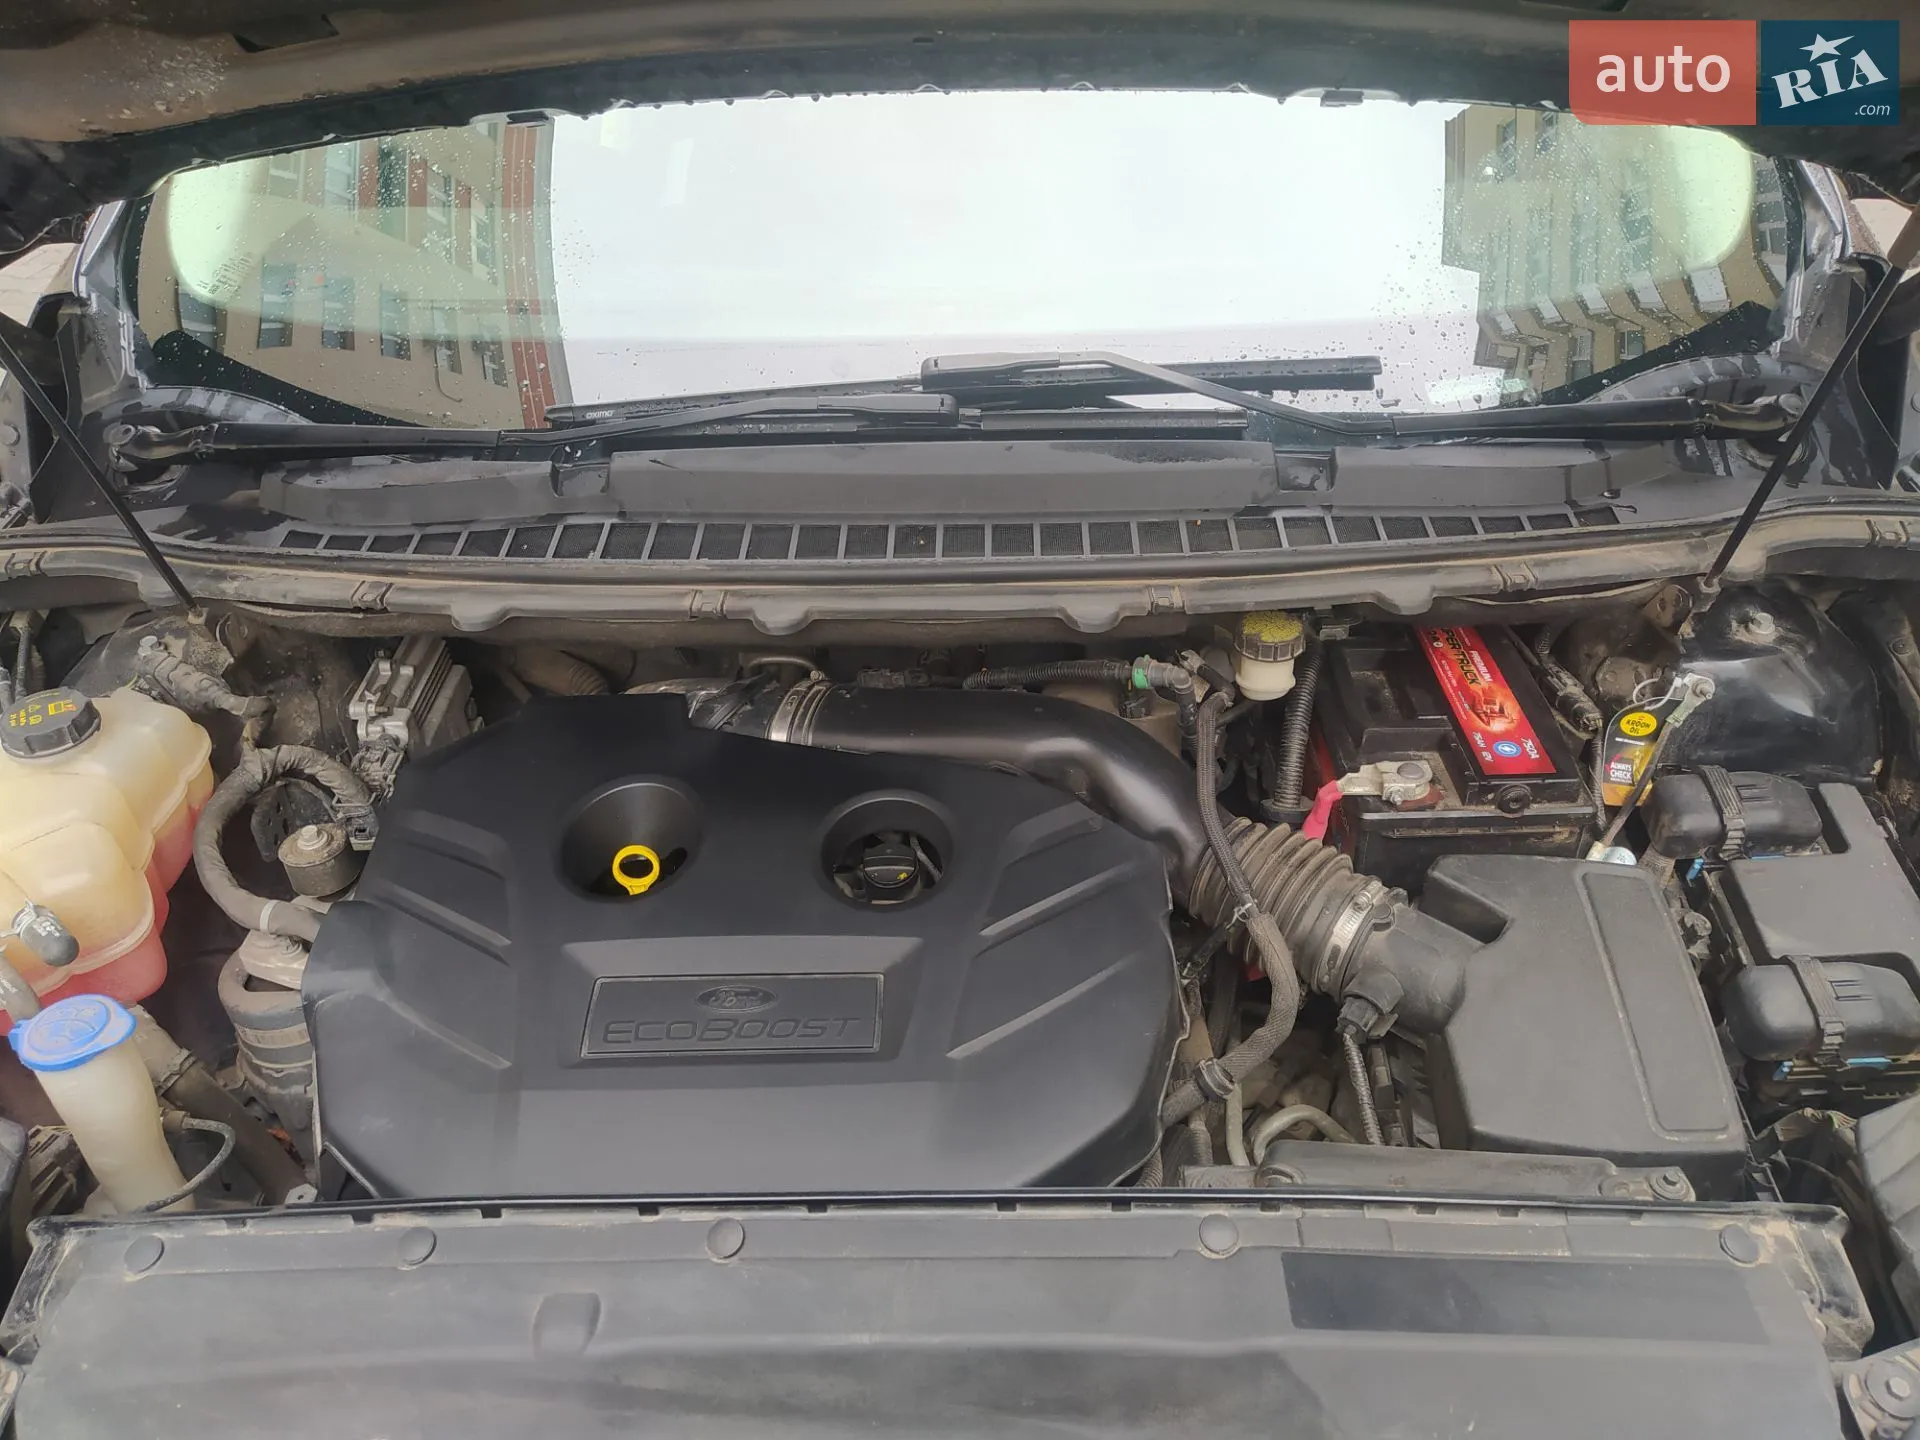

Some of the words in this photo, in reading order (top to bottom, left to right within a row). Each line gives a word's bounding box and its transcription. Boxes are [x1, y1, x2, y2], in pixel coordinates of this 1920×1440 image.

[1453, 650, 1482, 686] TRUCK
[1469, 650, 1493, 682] PREMIUM
[1626, 719, 1651, 729] KROON
[1520, 737, 1540, 759] 750A
[1610, 761, 1632, 771] ALWAYS
[1610, 770, 1632, 780] CHECK
